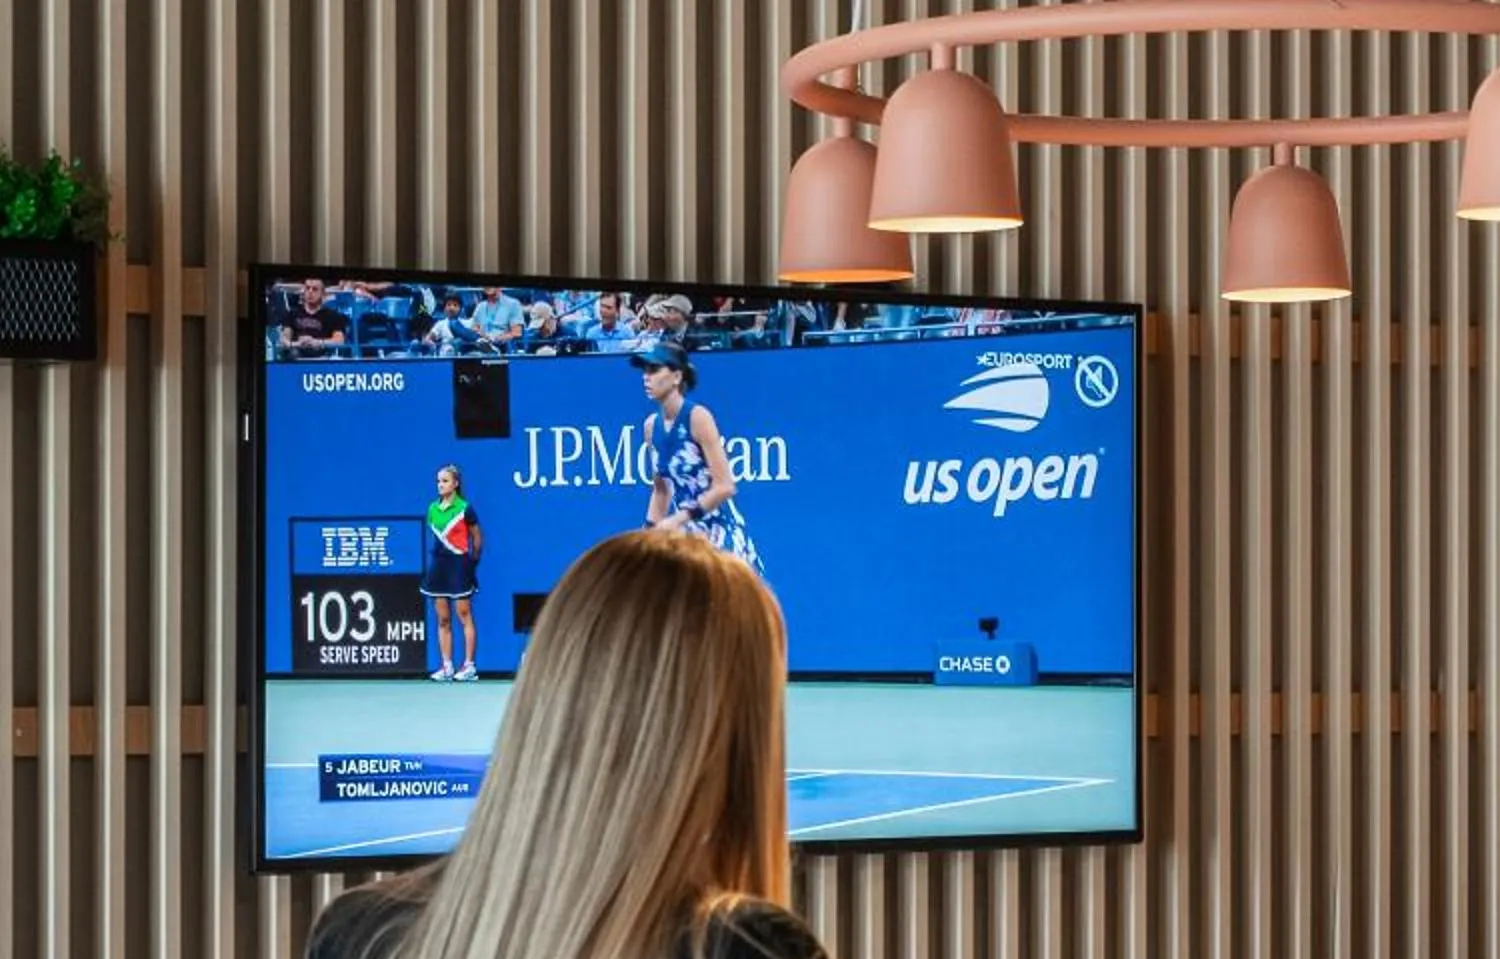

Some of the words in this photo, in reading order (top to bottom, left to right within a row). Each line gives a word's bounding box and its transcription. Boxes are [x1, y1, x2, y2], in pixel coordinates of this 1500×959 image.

[983, 351, 1073, 370] EUROSPORT
[302, 372, 405, 392] USOPEN.ORG
[514, 425, 791, 488] J.P.Man
[903, 459, 961, 505] us
[966, 452, 1101, 518] open
[321, 527, 390, 567] IBM
[301, 590, 377, 642] 103
[386, 621, 425, 641] MPH
[320, 645, 359, 663] SERVE
[361, 646, 399, 663] SPEED
[939, 656, 993, 673] CHASE
[324, 763, 333, 773] 5
[336, 759, 401, 775] JABEUR
[336, 780, 448, 798] TOMLJANOVIC
